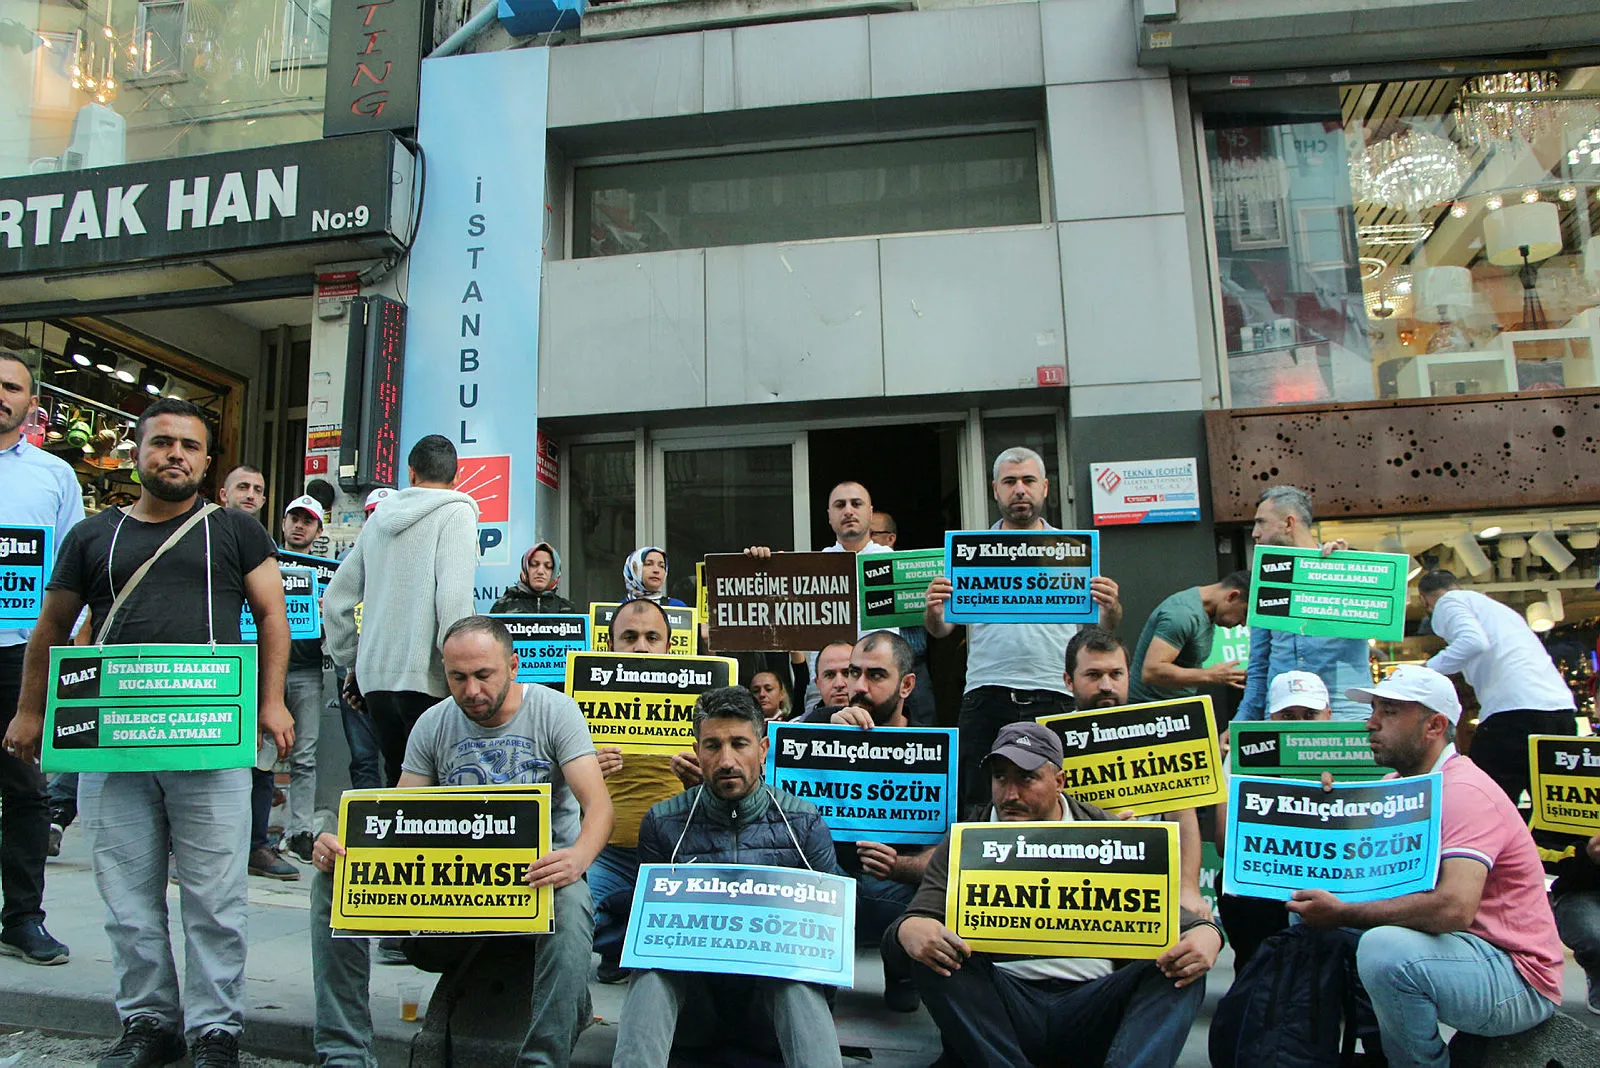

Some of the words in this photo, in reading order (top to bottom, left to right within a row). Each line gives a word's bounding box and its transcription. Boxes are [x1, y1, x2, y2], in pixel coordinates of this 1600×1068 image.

[166, 165, 299, 232] HAN
[311, 204, 370, 232] No:9
[459, 176, 486, 444] İSTANBUL
[957, 544, 977, 560] Ey
[979, 542, 1086, 560] Kılıçdaroğlu!
[865, 565, 890, 579] VAAT
[1262, 561, 1292, 573] VAAT
[1300, 559, 1346, 571] İSTANBUL
[1347, 563, 1389, 574] HALKINI
[716, 573, 789, 597] EKMEĞİME
[792, 575, 849, 595] UZANAN
[957, 577, 1023, 590] NAMUS
[1026, 573, 1086, 590] SÖZÜN
[1308, 572, 1378, 584] KUCAKLAMAK!
[957, 593, 999, 607] SEÇİME
[1002, 595, 1045, 604] KADAR
[1049, 595, 1086, 604] MIYDI?
[1259, 597, 1289, 608] İCRAAT
[1295, 593, 1341, 605] BİNLERCE
[717, 603, 769, 626] ELLER
[774, 601, 850, 625] KIRILSIN
[1301, 604, 1340, 616] SOKAĞA
[1341, 608, 1380, 619] ATMAK!
[60, 667, 97, 687] VAAT
[107, 660, 171, 675] İSTANBUL
[173, 662, 231, 674] HALKINI
[590, 667, 614, 685] Ey
[616, 664, 712, 687] İmamoğlu!
[118, 678, 217, 690] KUCAKLAMAK!
[103, 710, 166, 724] BİNLERCE
[168, 711, 233, 726] ÇALIŞANI
[579, 697, 641, 721] HANİ
[56, 720, 96, 738] İCRAAT
[112, 727, 166, 741] SOKAĞA
[169, 727, 221, 740] ATMAK!
[1065, 730, 1089, 749] Ey
[1091, 714, 1191, 743] İmamoğlu!
[782, 739, 808, 760] Ey
[811, 740, 942, 765] Kılıçdaroğlu!
[1240, 739, 1277, 757] VAAT
[1286, 735, 1343, 747] İSTANBUL
[1064, 755, 1127, 789] HANİ
[1130, 750, 1208, 776] KİMSE
[1554, 751, 1580, 770] Ey
[781, 780, 862, 800] NAMUS
[867, 779, 941, 802] SÖZÜN
[1117, 775, 1210, 797] OLMAYACAKTI?
[836, 807, 886, 819] KADAR
[890, 808, 941, 821] MIYDI?
[1245, 793, 1274, 815] Ey
[1277, 792, 1425, 822] Kılıçdaroğlu!
[1547, 803, 1599, 819] İŞİNDEN
[365, 815, 393, 839] Ey
[395, 809, 516, 840] İmamoğlu!
[982, 840, 1013, 863] Ey
[1016, 835, 1145, 865] İmamoğlu!
[1243, 835, 1337, 860] NAMUS
[1343, 832, 1423, 860] SÖZÜN
[350, 854, 425, 885] HANİ
[431, 854, 531, 886] KİMSE
[1243, 859, 1303, 877] SEÇİME
[1307, 866, 1365, 880] KADAR
[1369, 857, 1421, 877] MIYDI?
[347, 889, 407, 908] İŞİNDEN
[410, 893, 532, 907] OLMAYACAKTI?
[653, 877, 684, 896] Ey
[686, 878, 837, 904] Kılıçdaroğlu!
[965, 877, 1051, 909] HANİ
[1057, 878, 1161, 913] KİMSE
[647, 913, 743, 932] NAMUS
[749, 913, 836, 943] SÖZÜN
[964, 910, 1031, 930] İŞİNDEN
[1034, 917, 1161, 934] OLMAYACAKTI?
[644, 932, 707, 950] SEÇİME
[710, 936, 772, 952] KADAR
[774, 942, 835, 960] MIYDI?
